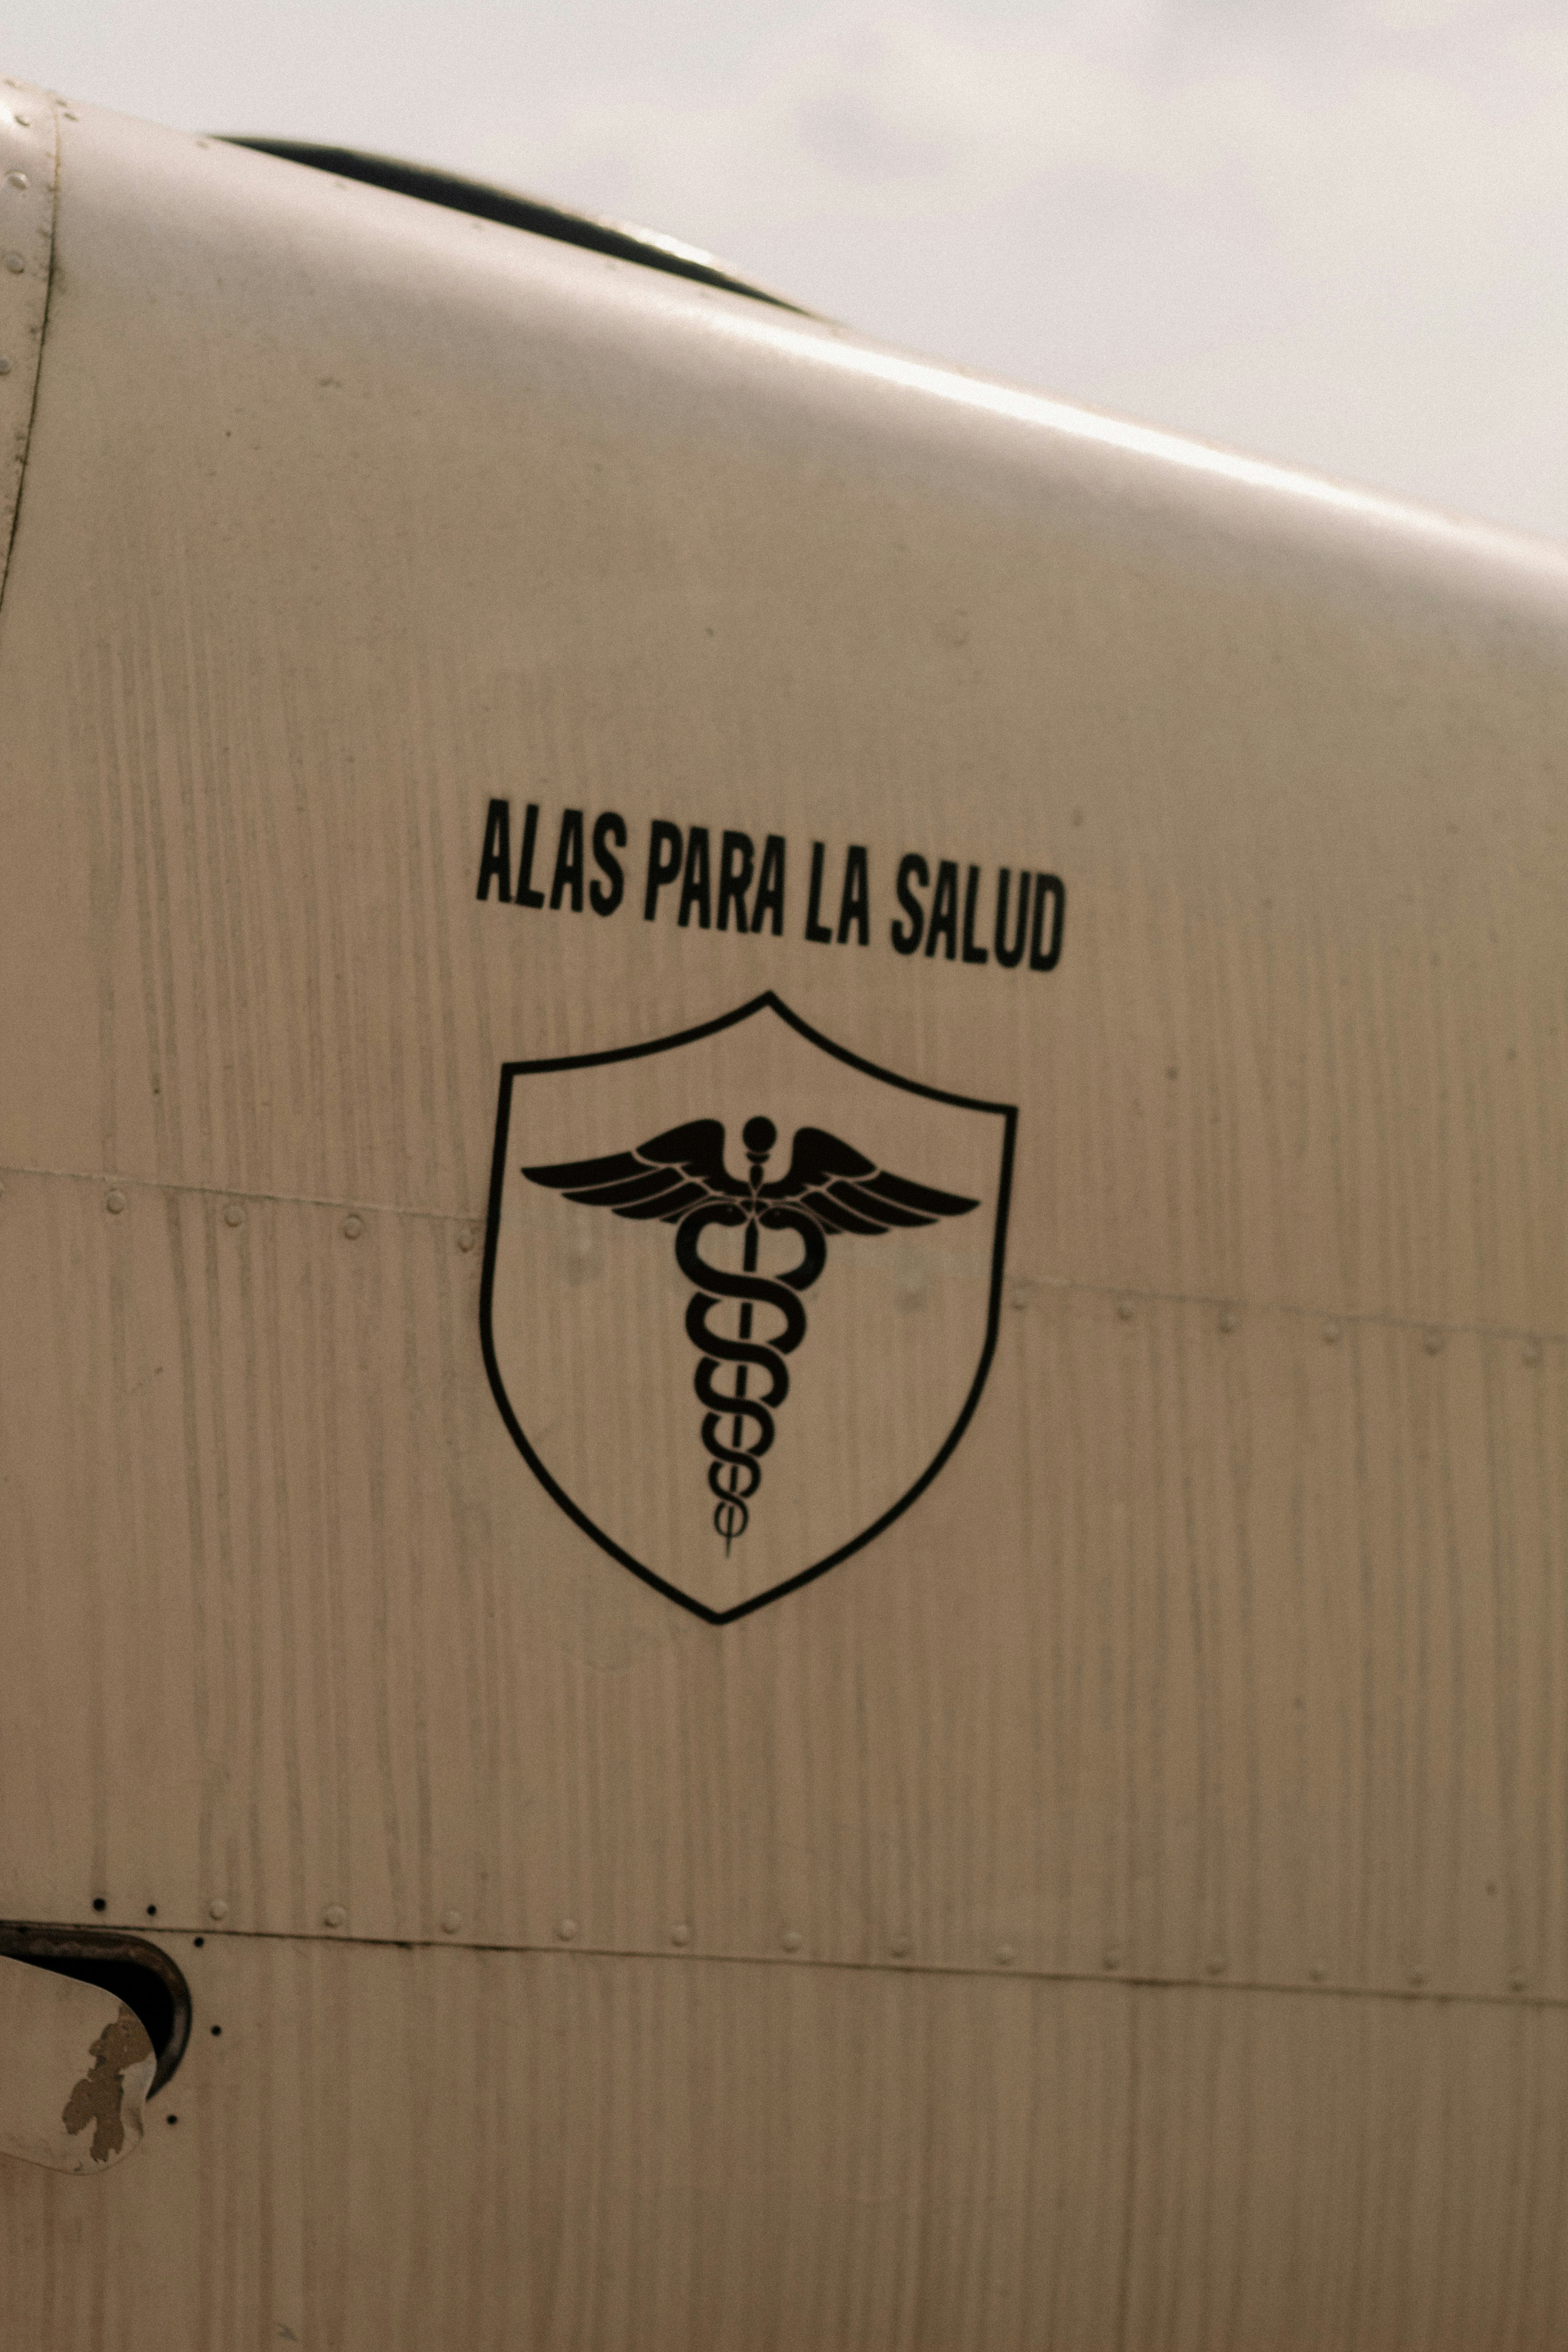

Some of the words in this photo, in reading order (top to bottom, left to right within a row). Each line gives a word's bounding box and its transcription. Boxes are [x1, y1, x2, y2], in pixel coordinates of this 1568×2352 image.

[475, 798, 627, 917] ALAS
[643, 819, 786, 937] PARA
[804, 841, 870, 947] LA
[890, 853, 1066, 973] SALUD
